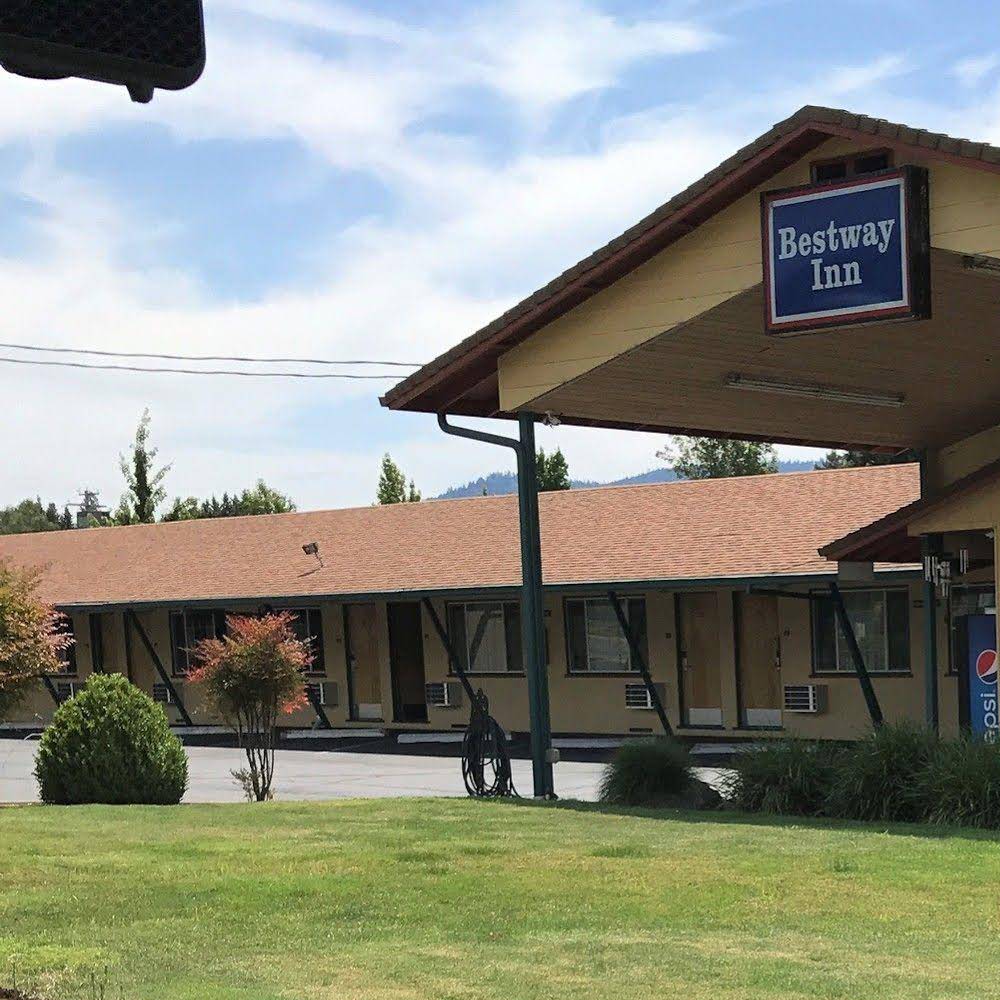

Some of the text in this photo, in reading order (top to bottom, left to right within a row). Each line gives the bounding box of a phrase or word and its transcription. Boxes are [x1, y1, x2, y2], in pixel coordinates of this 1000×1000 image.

[778, 218, 896, 260] Bestway
[811, 258, 863, 291] Inn
[980, 692, 999, 745] epsi
